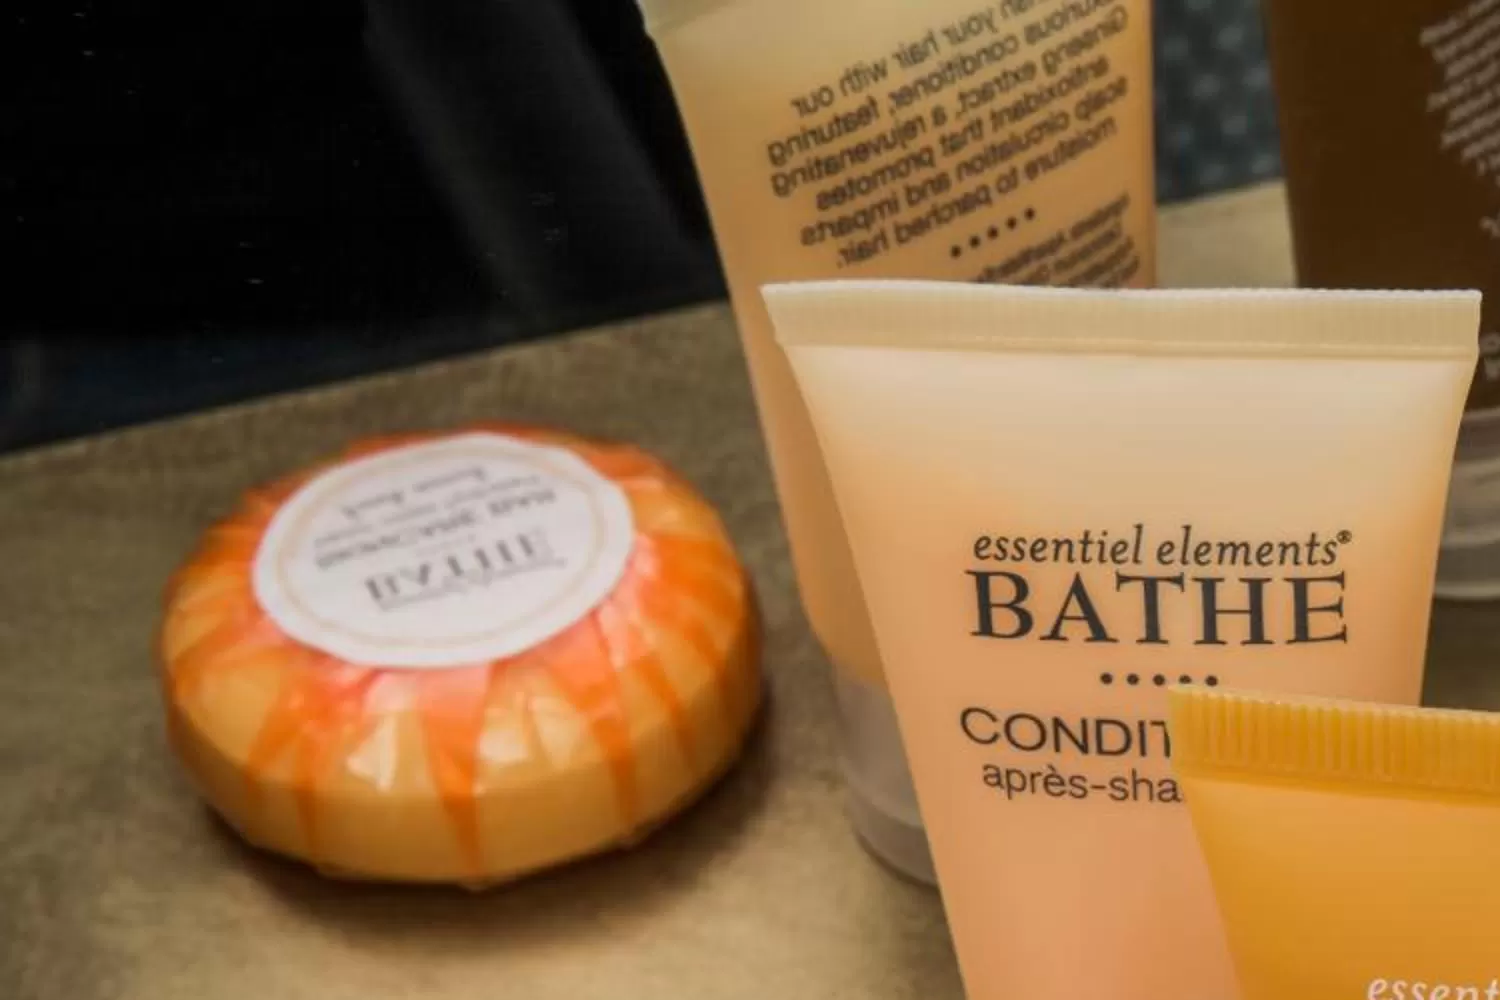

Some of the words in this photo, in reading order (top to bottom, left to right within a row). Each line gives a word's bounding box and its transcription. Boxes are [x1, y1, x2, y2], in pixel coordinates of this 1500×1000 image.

[973, 523, 1144, 563] essentiel
[965, 569, 1348, 645] BATHE
[959, 707, 1171, 760] CONDIT
[982, 763, 1182, 802] après-sha
